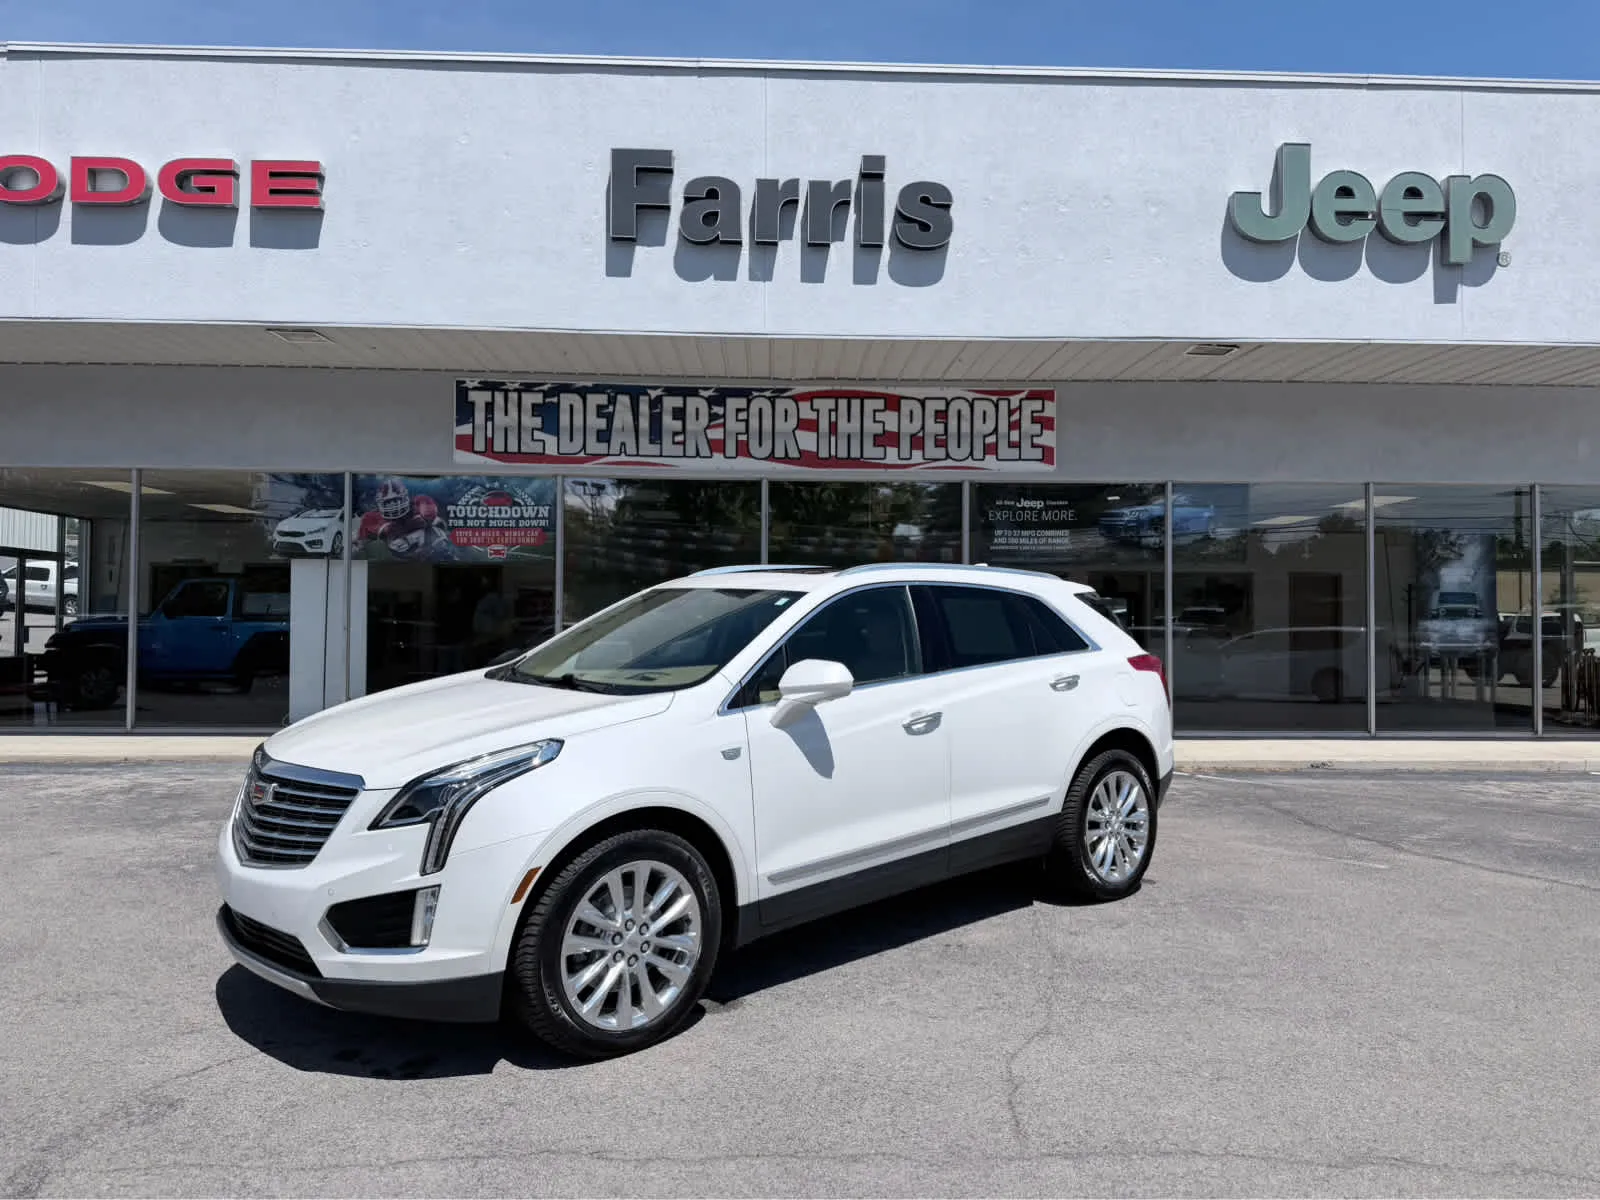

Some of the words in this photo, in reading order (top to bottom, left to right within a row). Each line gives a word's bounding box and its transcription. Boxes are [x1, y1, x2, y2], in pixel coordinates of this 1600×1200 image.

[609, 148, 953, 249] Farris
[1229, 142, 1516, 265] Jeep
[467, 390, 546, 454] THE
[557, 392, 712, 458] DEALER
[723, 395, 801, 460] FOR
[810, 396, 887, 460] THE
[898, 396, 1045, 461] PEOPLE
[1016, 498, 1044, 509] Jeep
[447, 505, 550, 518] TOUCHDOWN
[988, 510, 1039, 521] EXPLORE
[1042, 510, 1078, 521] MORE.
[448, 519, 464, 527] FOR
[467, 519, 486, 527] NOT
[489, 519, 515, 527] MUCH
[519, 519, 549, 527] DOWN!
